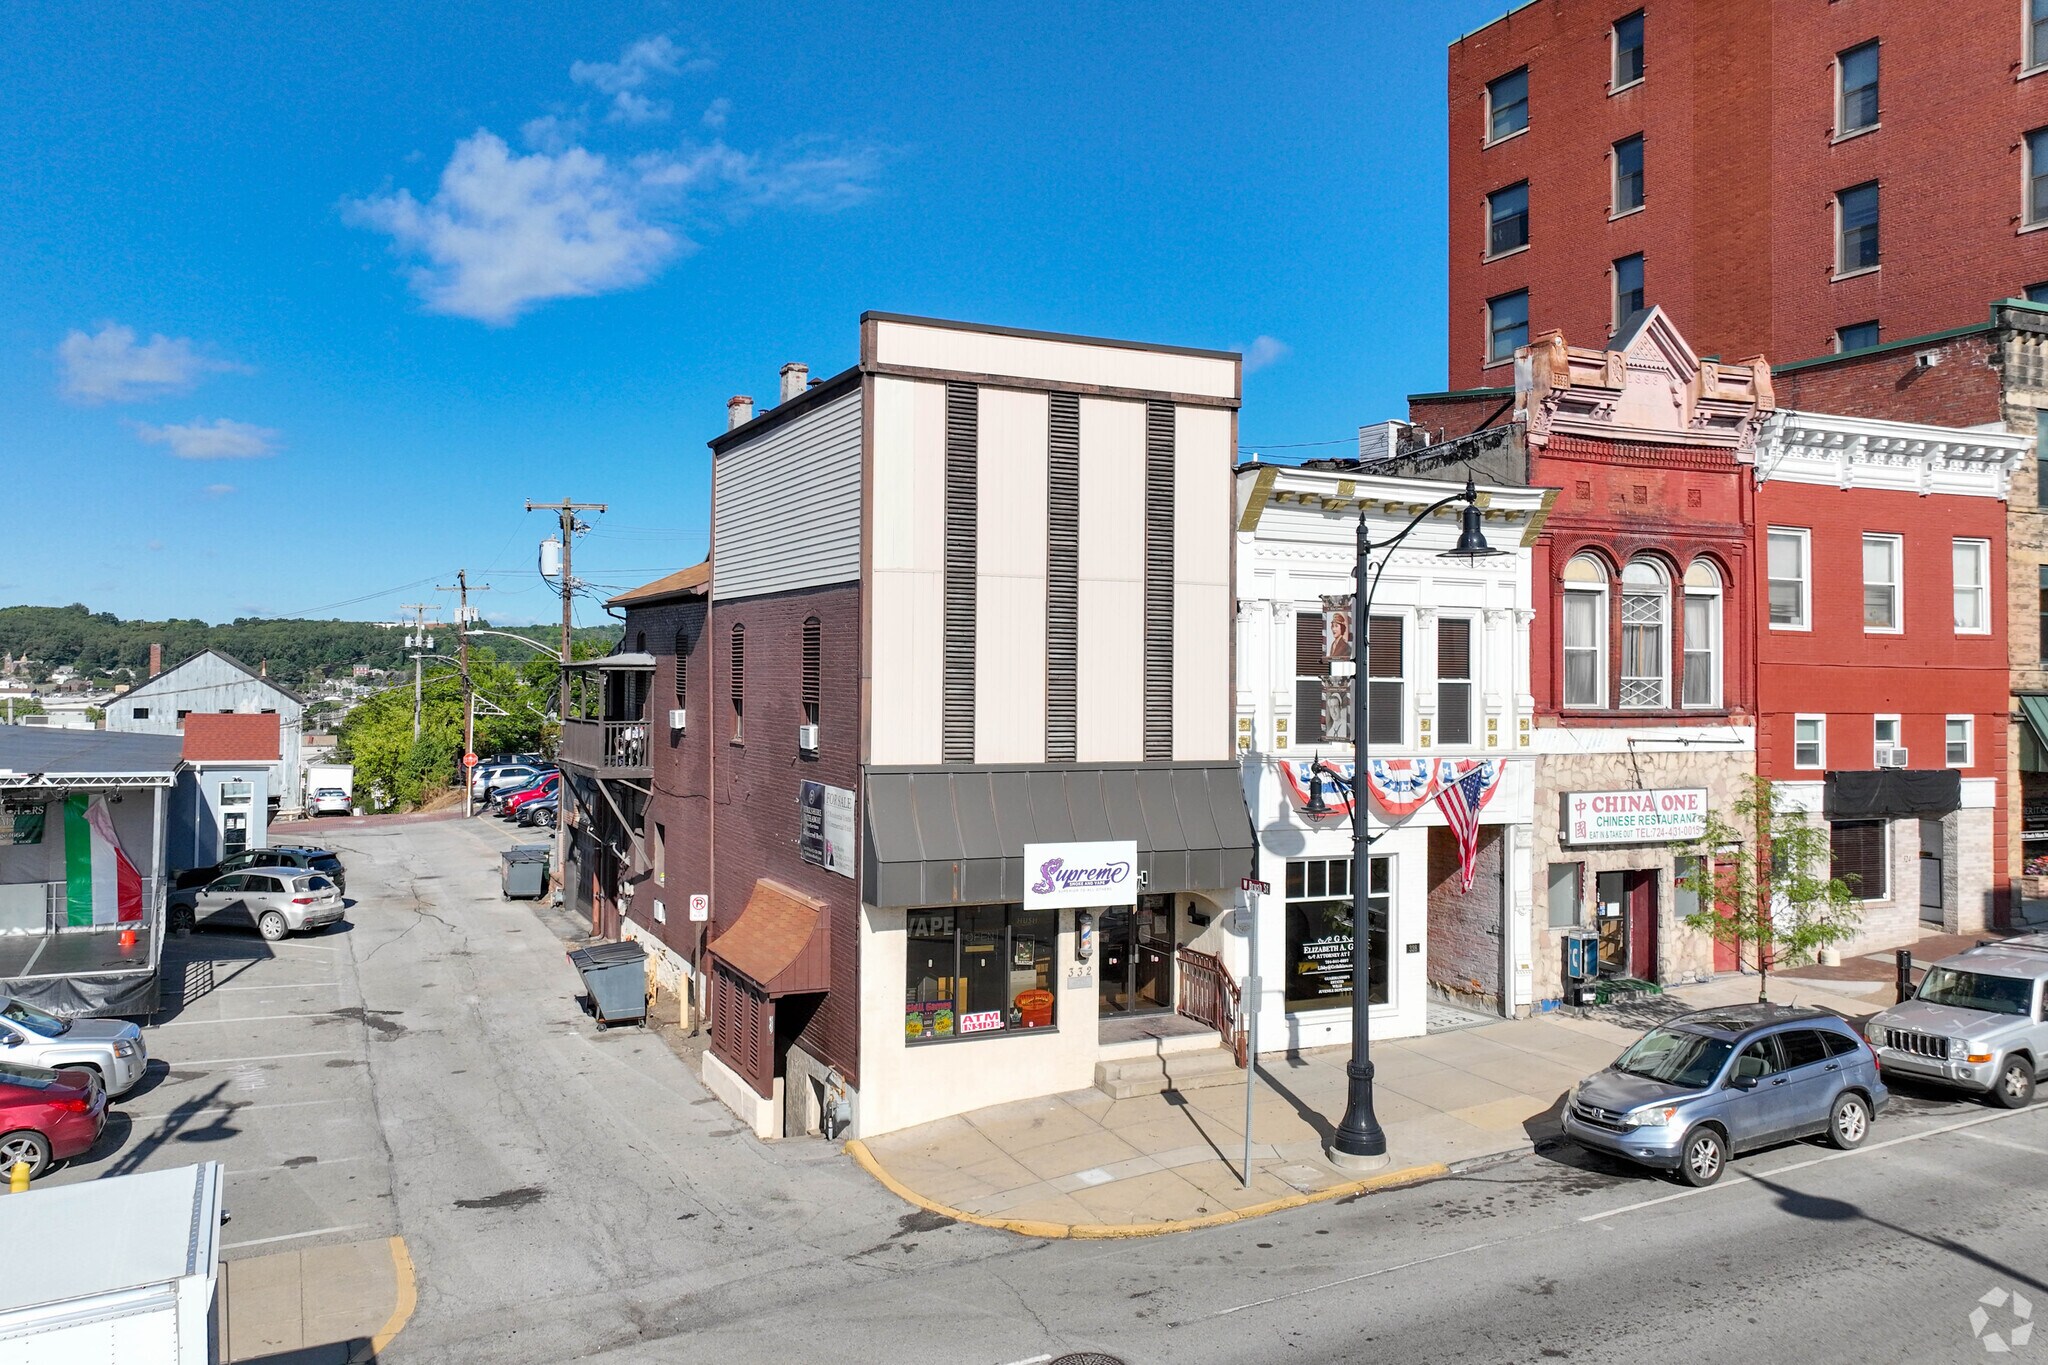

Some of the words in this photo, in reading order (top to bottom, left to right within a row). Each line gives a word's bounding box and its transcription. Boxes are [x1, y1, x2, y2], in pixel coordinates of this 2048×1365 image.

[826, 792, 838, 805] FOR
[838, 795, 852, 809] SALE
[1592, 795, 1656, 813] CHINA
[1661, 794, 1698, 811] ONE
[1596, 815, 1635, 827] CHINESE
[1638, 813, 1697, 826] RESTAURANT
[1589, 831, 1598, 839] EAT
[1599, 831, 1605, 839] IN
[1610, 830, 1622, 838] TAKE
[1623, 830, 1633, 838] OUT
[1032, 857, 1130, 895] Supreme
[1249, 881, 1262, 891] Brush
[1263, 883, 1269, 892] St
[1303, 945, 1339, 954] ELIZABETH
[1068, 966, 1092, 978] 332
[963, 1012, 999, 1023] ATM
[963, 1021, 1000, 1032] INSIDE
